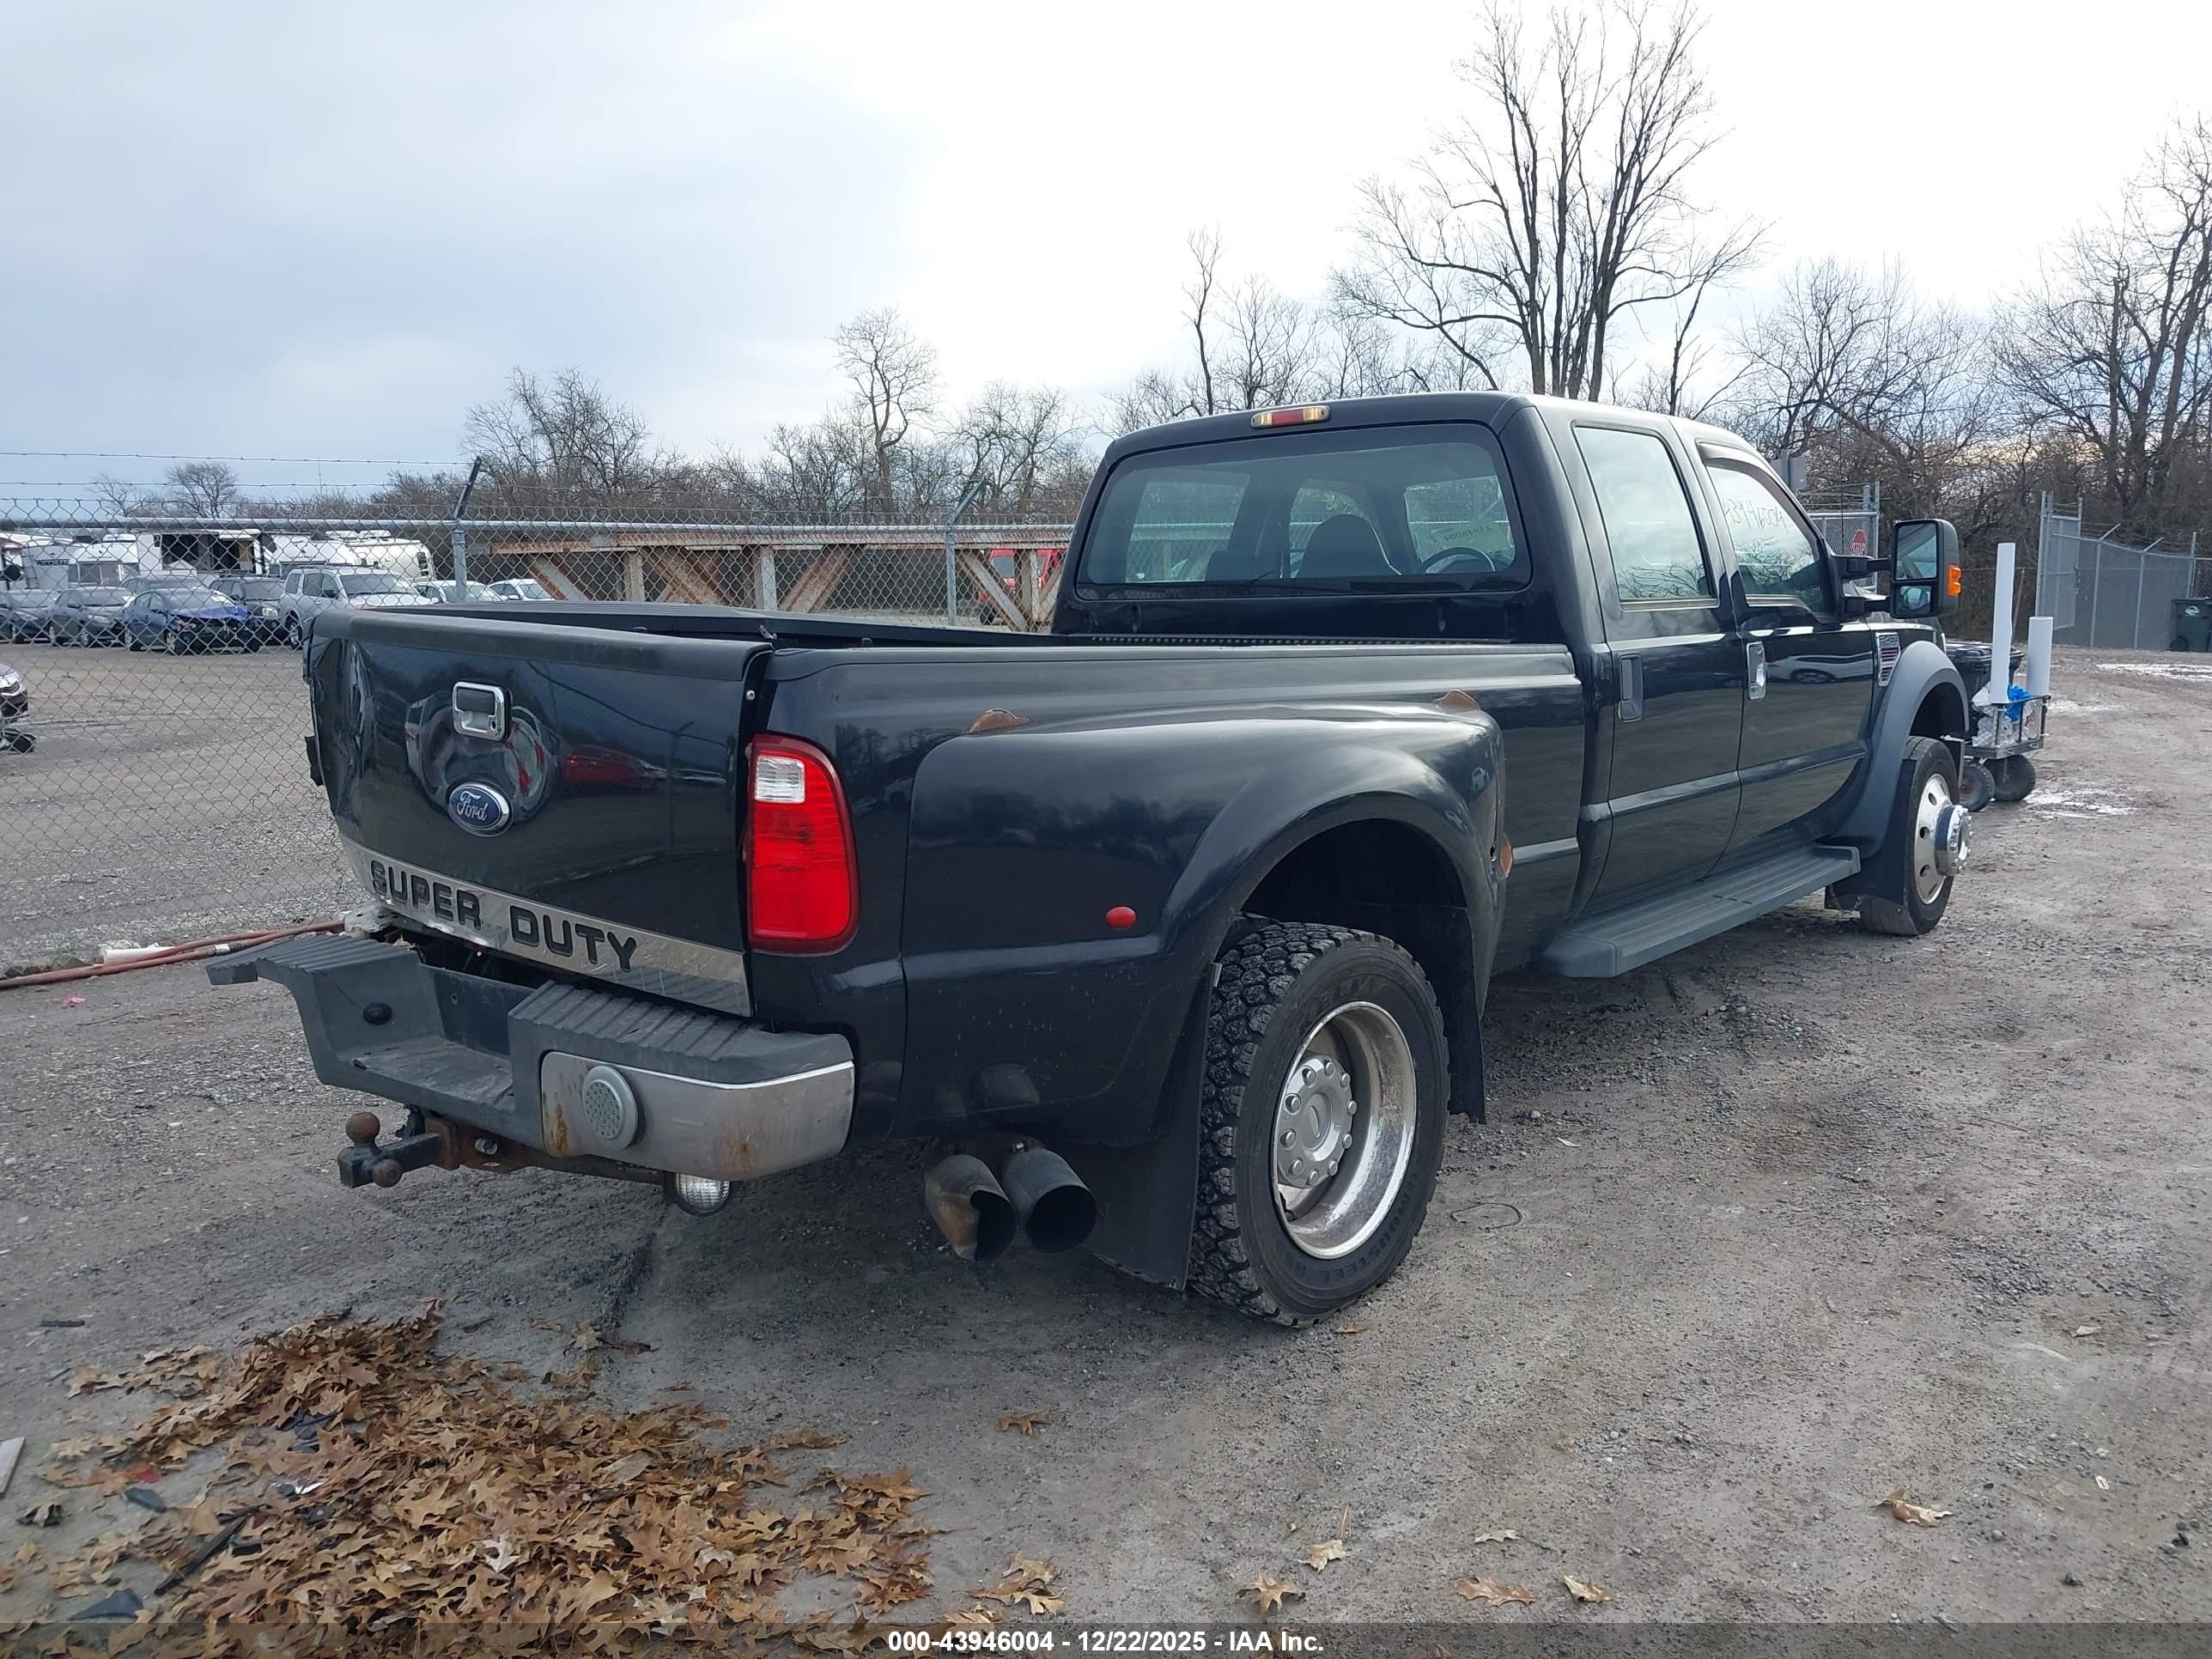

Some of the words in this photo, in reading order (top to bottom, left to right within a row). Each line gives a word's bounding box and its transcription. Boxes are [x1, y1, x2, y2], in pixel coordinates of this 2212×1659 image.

[457, 790, 489, 821] Ford
[371, 860, 482, 931] SUPER
[510, 905, 637, 973] DUTY
